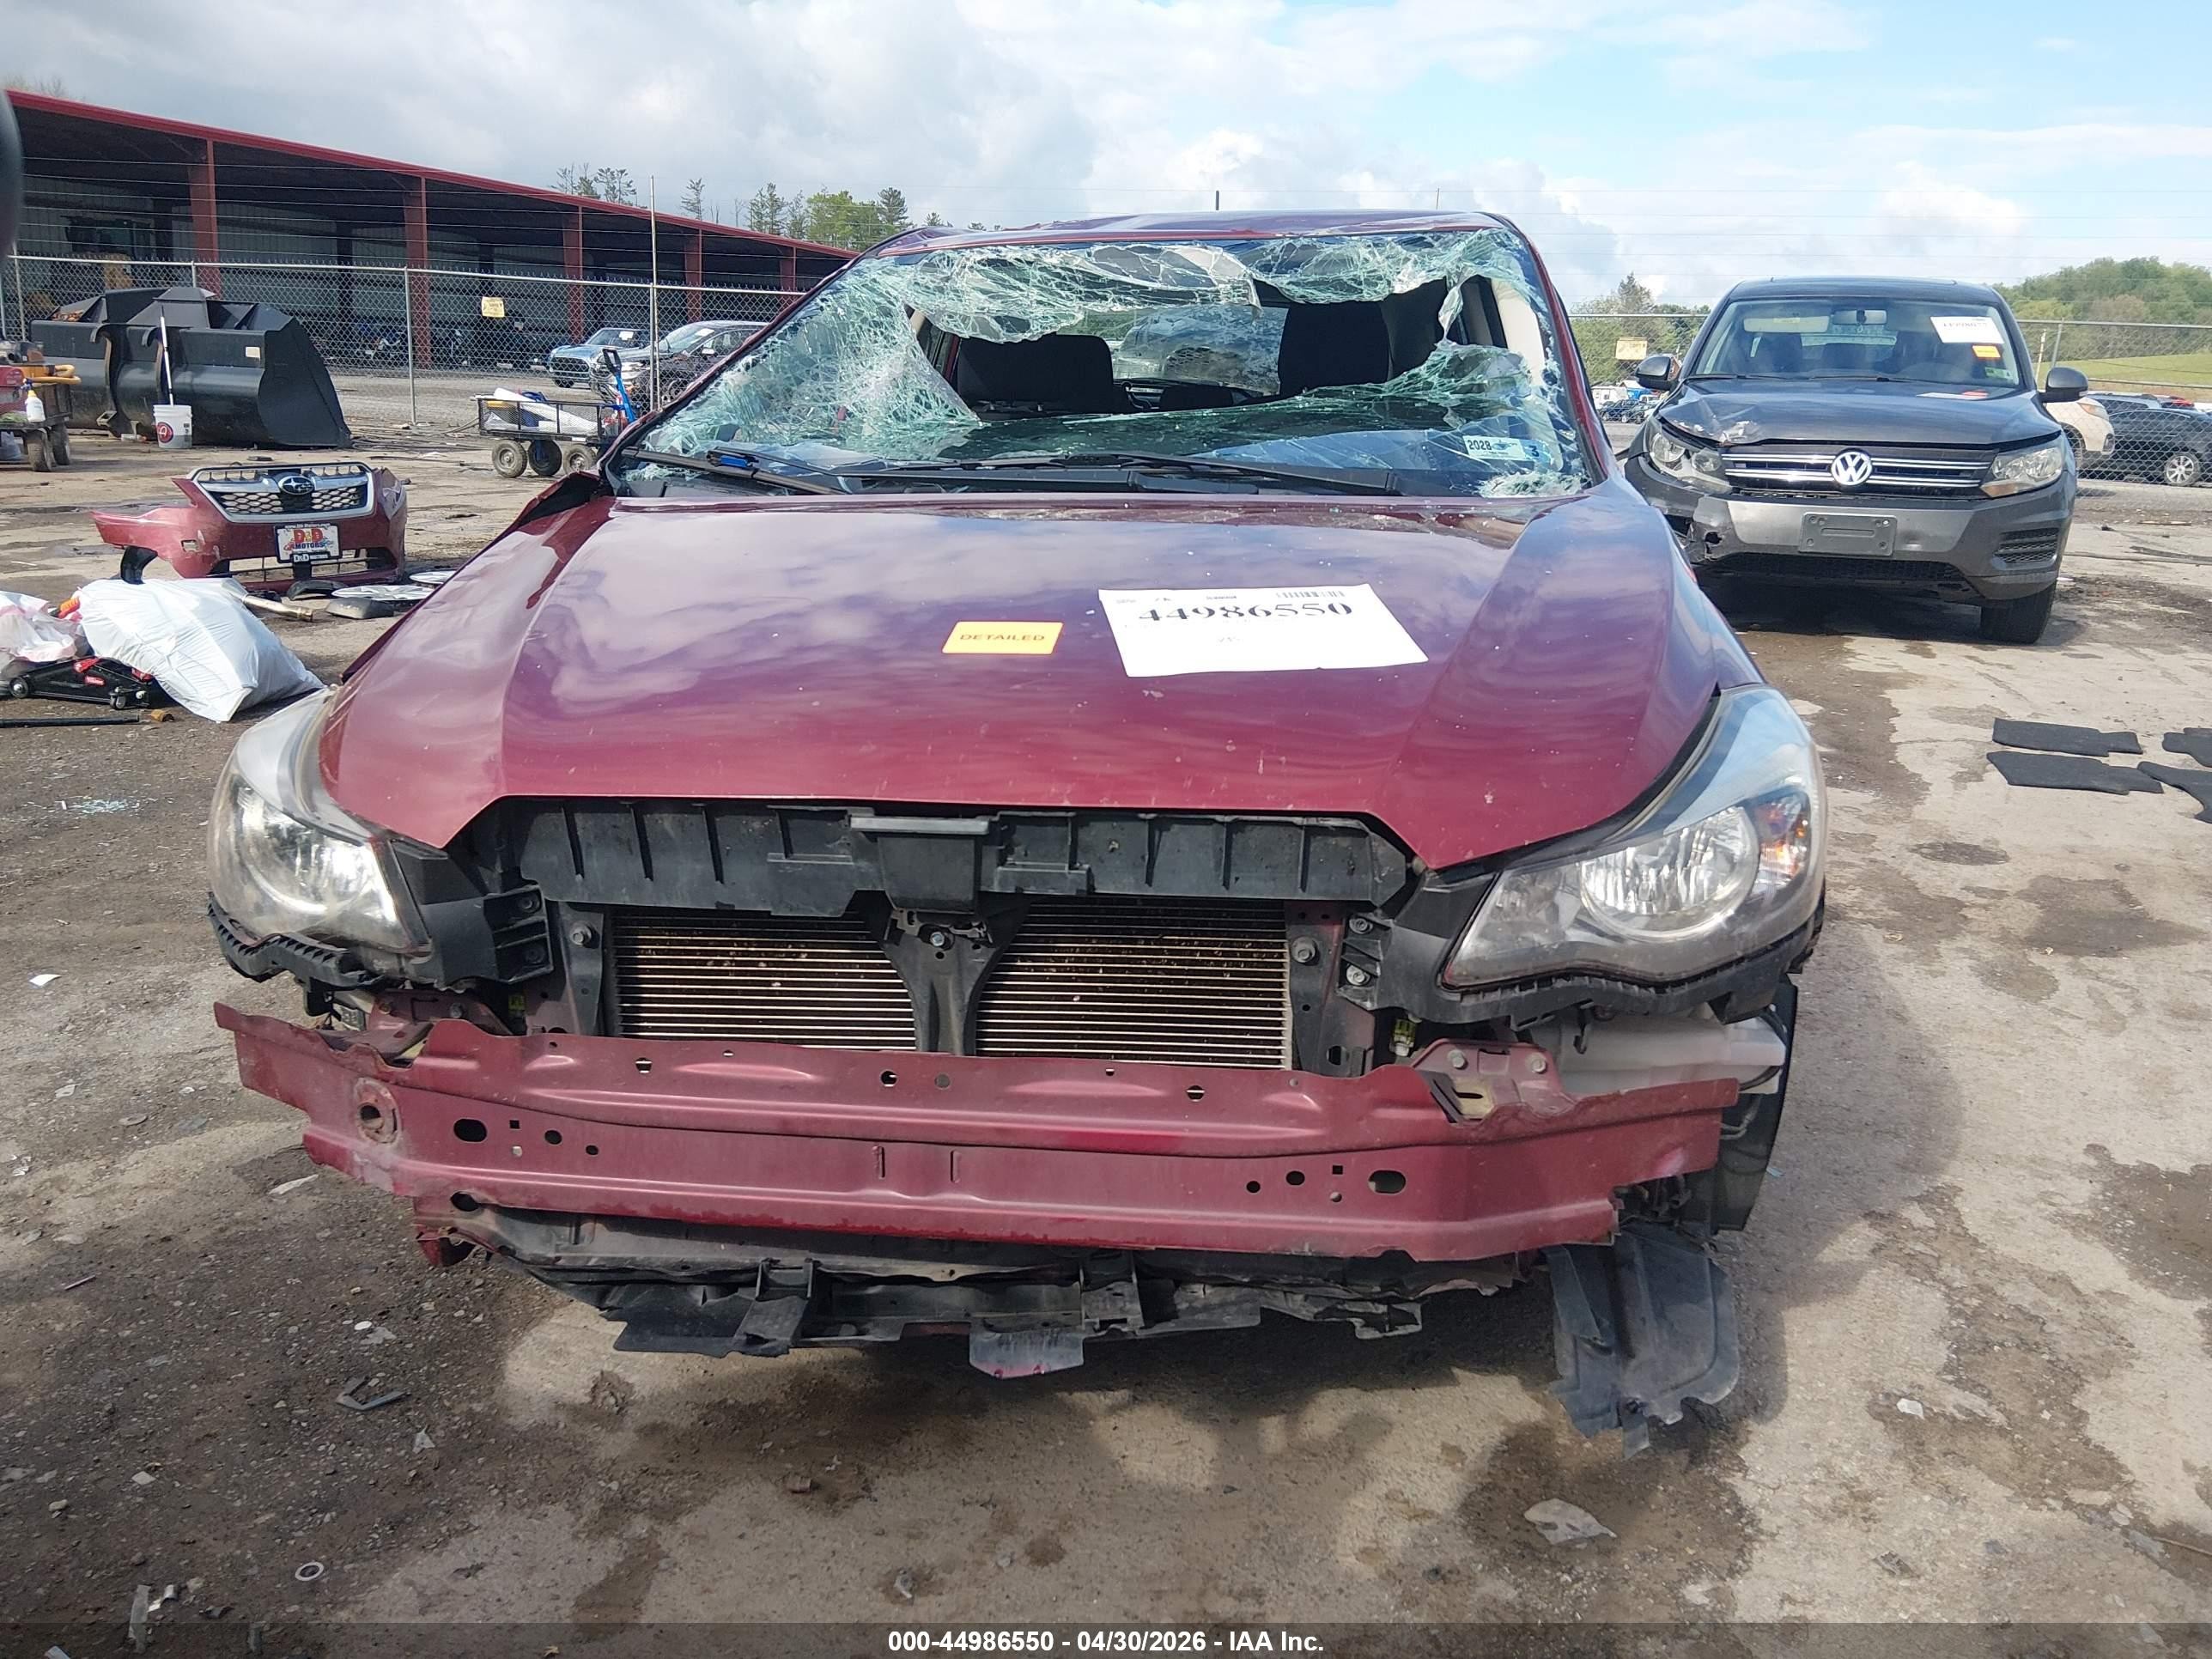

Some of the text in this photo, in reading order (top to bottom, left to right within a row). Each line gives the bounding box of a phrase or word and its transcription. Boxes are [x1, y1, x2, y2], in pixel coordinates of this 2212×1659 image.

[1468, 440, 1492, 451] 2028
[1528, 445, 1540, 457] 3
[1139, 602, 1352, 622] 44986550
